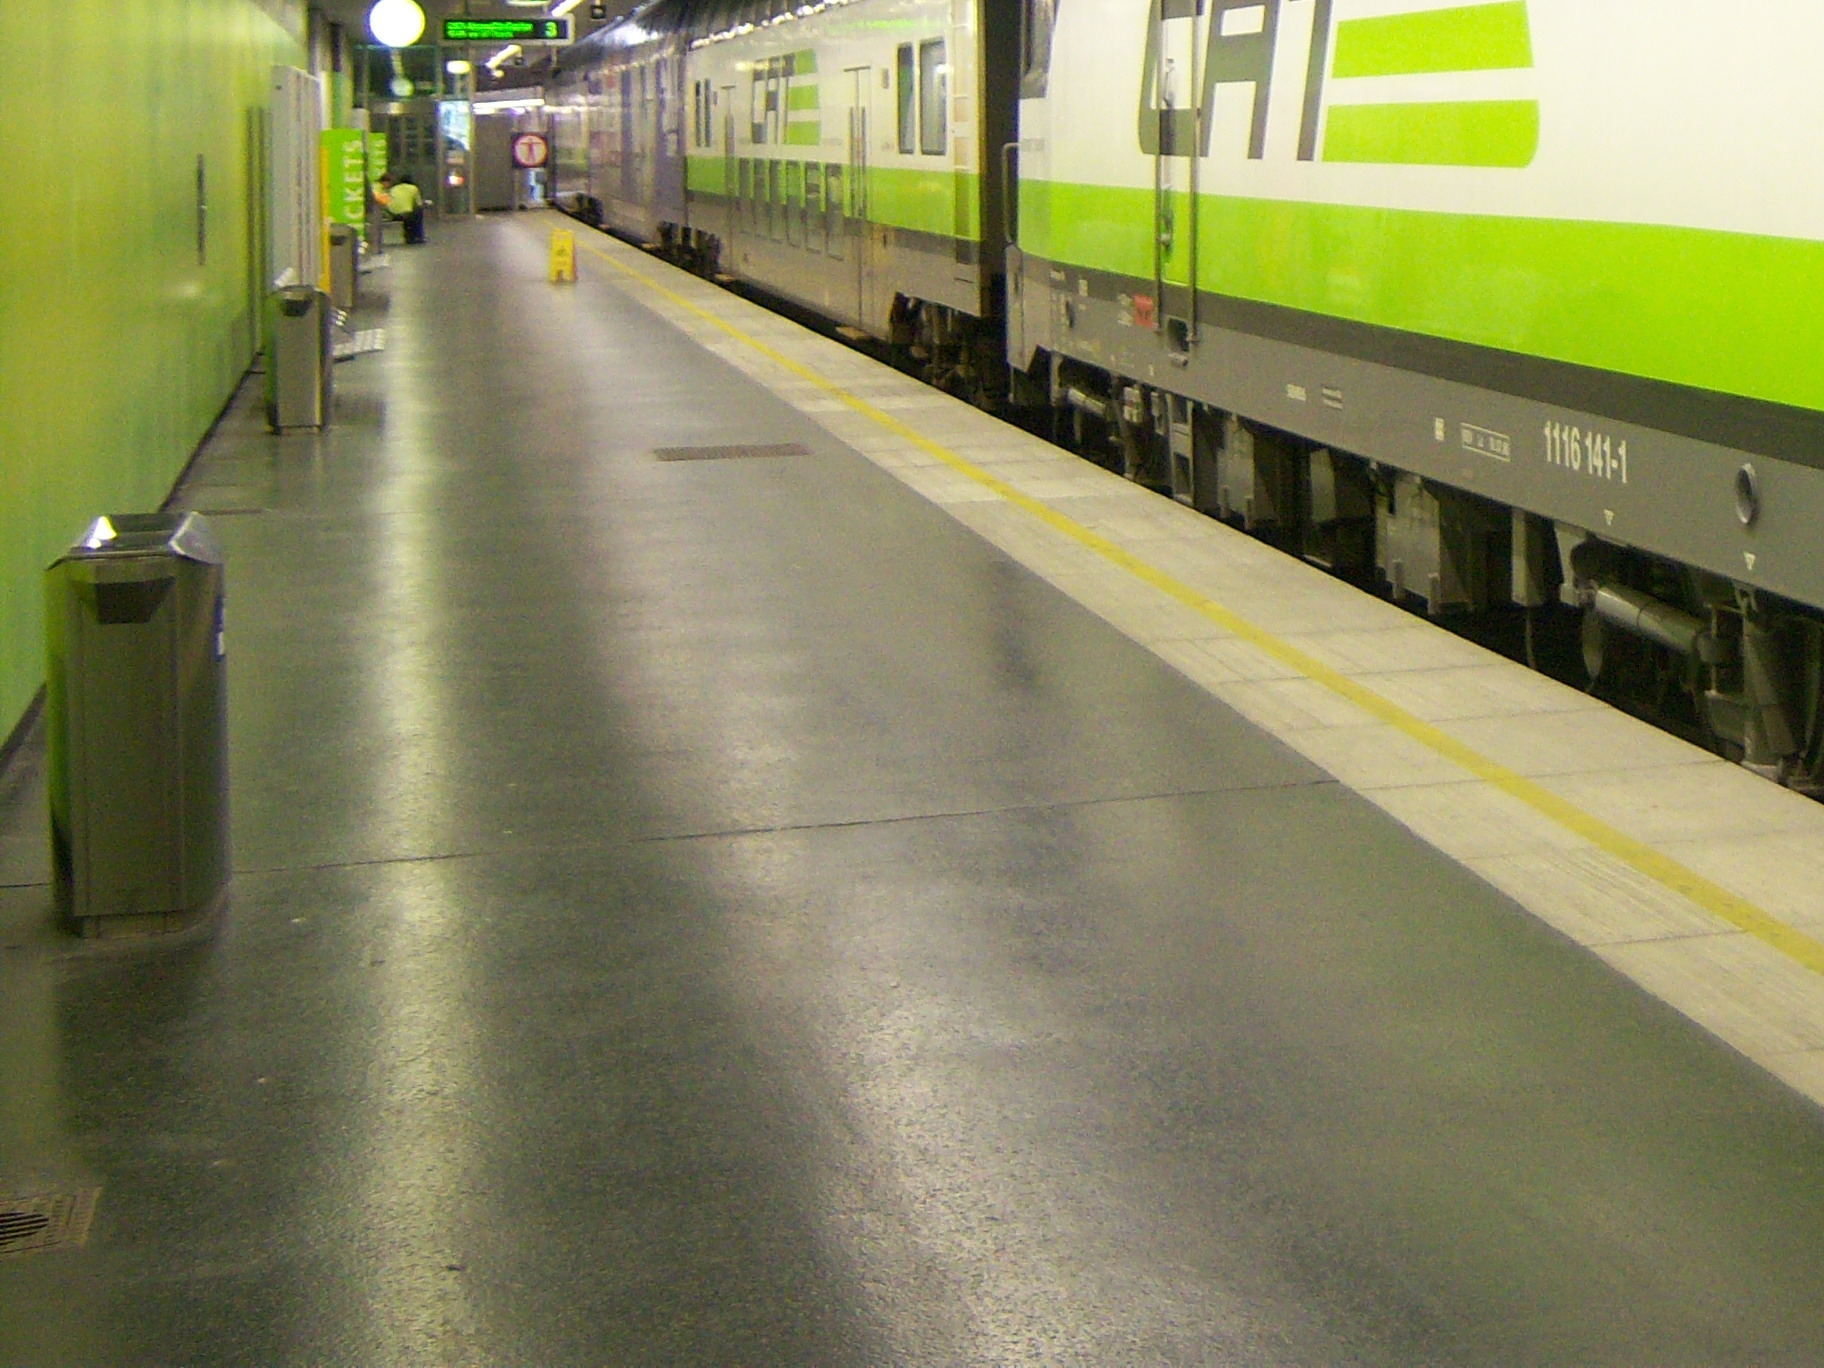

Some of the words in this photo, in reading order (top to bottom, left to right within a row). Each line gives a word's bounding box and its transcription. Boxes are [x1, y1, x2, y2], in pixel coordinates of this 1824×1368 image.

[545, 21, 558, 38] 3
[1544, 420, 1582, 471] 1116
[1585, 431, 1628, 485] 141-1
